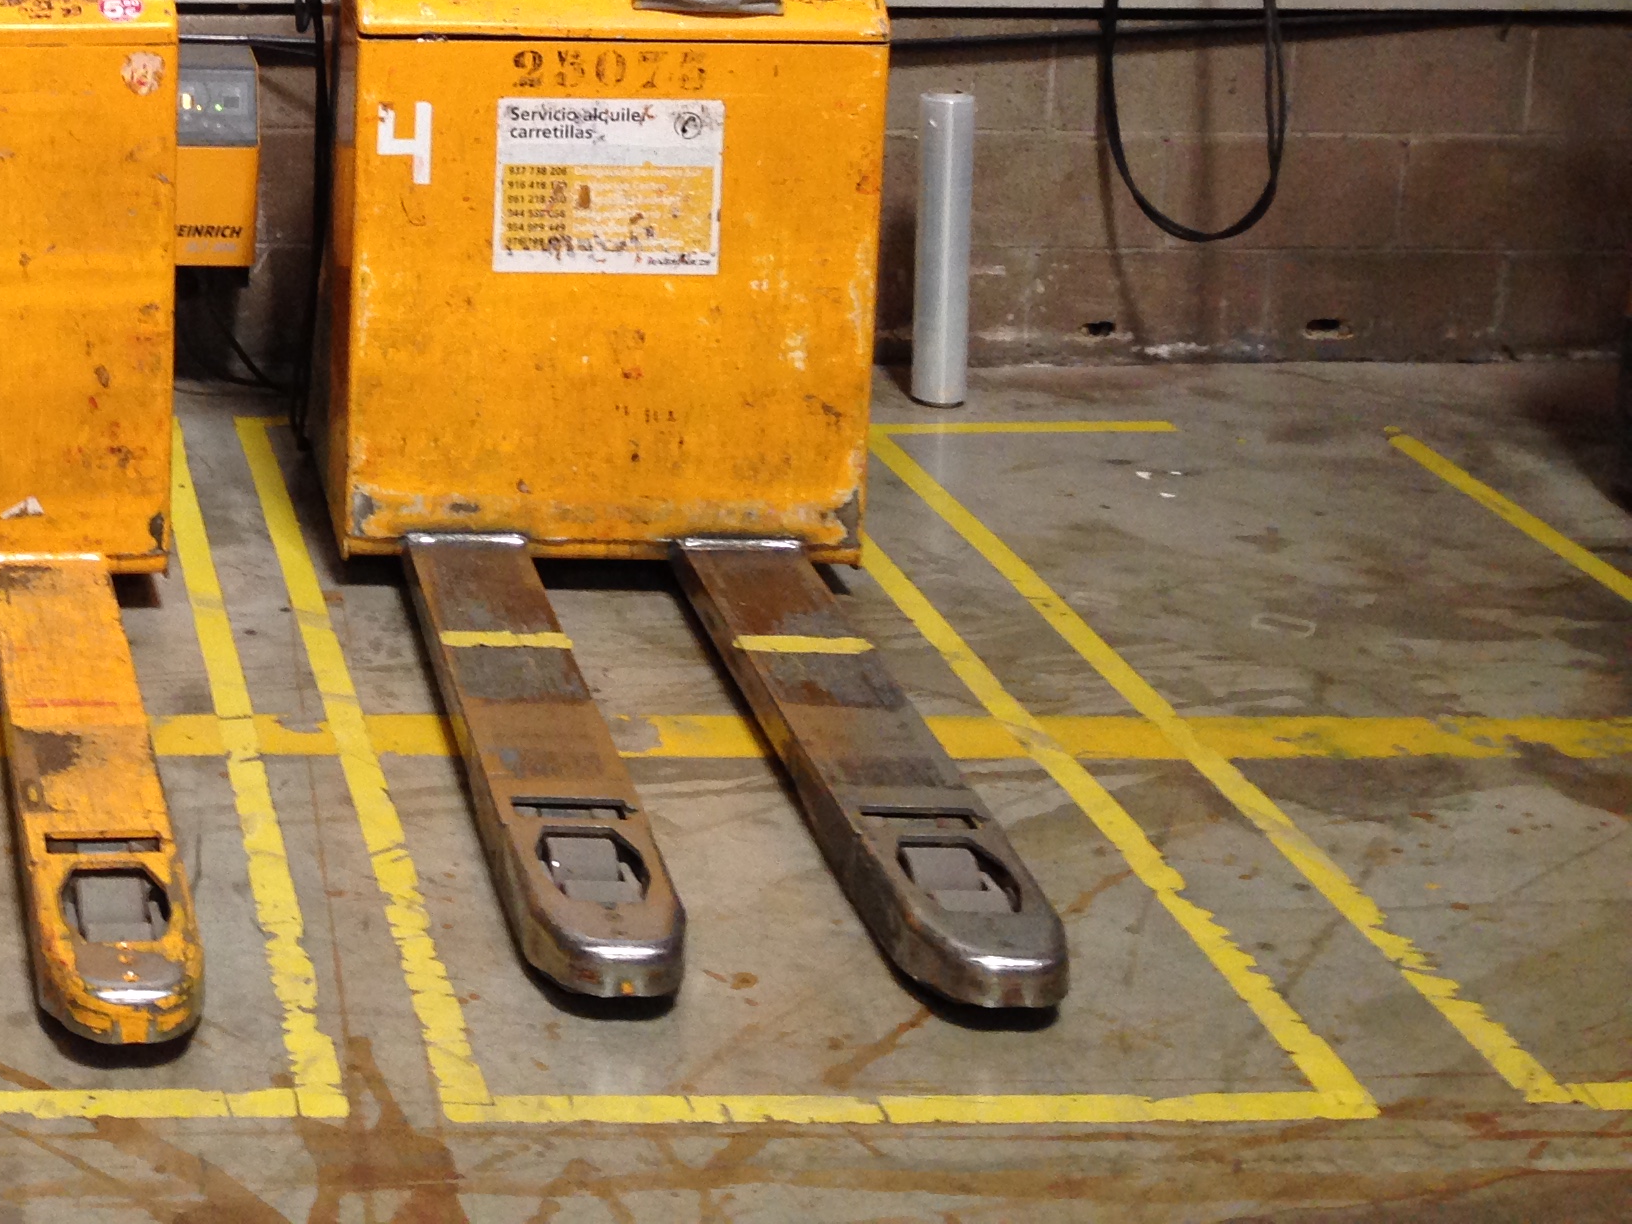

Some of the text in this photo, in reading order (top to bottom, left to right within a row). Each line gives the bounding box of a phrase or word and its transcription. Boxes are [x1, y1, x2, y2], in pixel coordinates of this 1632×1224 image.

[509, 106, 578, 122] Servicio
[509, 124, 594, 140] carretillas
[376, 100, 433, 186] 4
[173, 224, 243, 238] EINRICH
